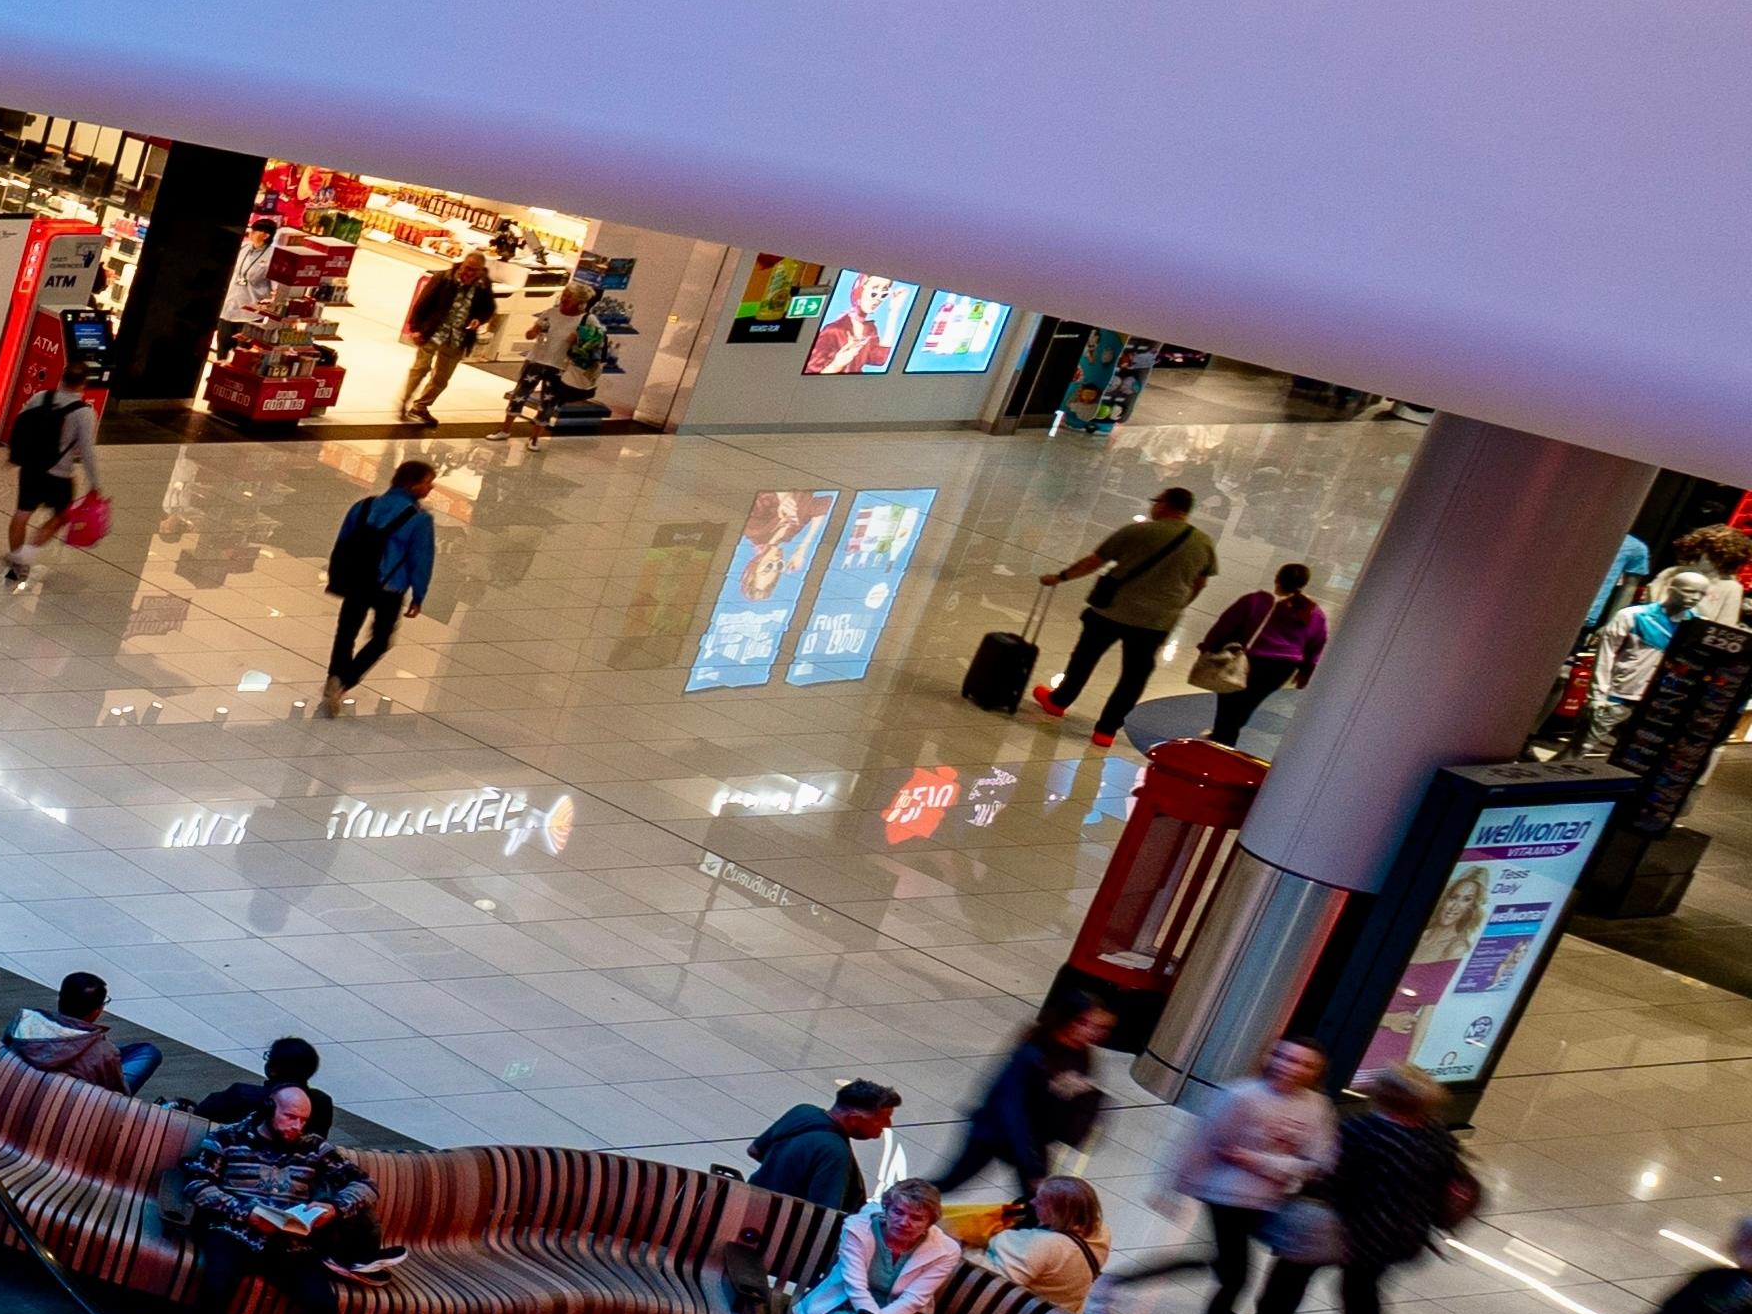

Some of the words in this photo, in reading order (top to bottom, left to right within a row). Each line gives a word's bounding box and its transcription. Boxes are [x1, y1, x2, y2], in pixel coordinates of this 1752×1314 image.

[44, 275, 77, 289] ATM
[32, 335, 60, 356] ATM
[1474, 814, 1593, 846] wellwoman
[1506, 844, 1568, 858] VITAMINS
[1499, 867, 1531, 881] Tess
[1490, 881, 1522, 896] Daly
